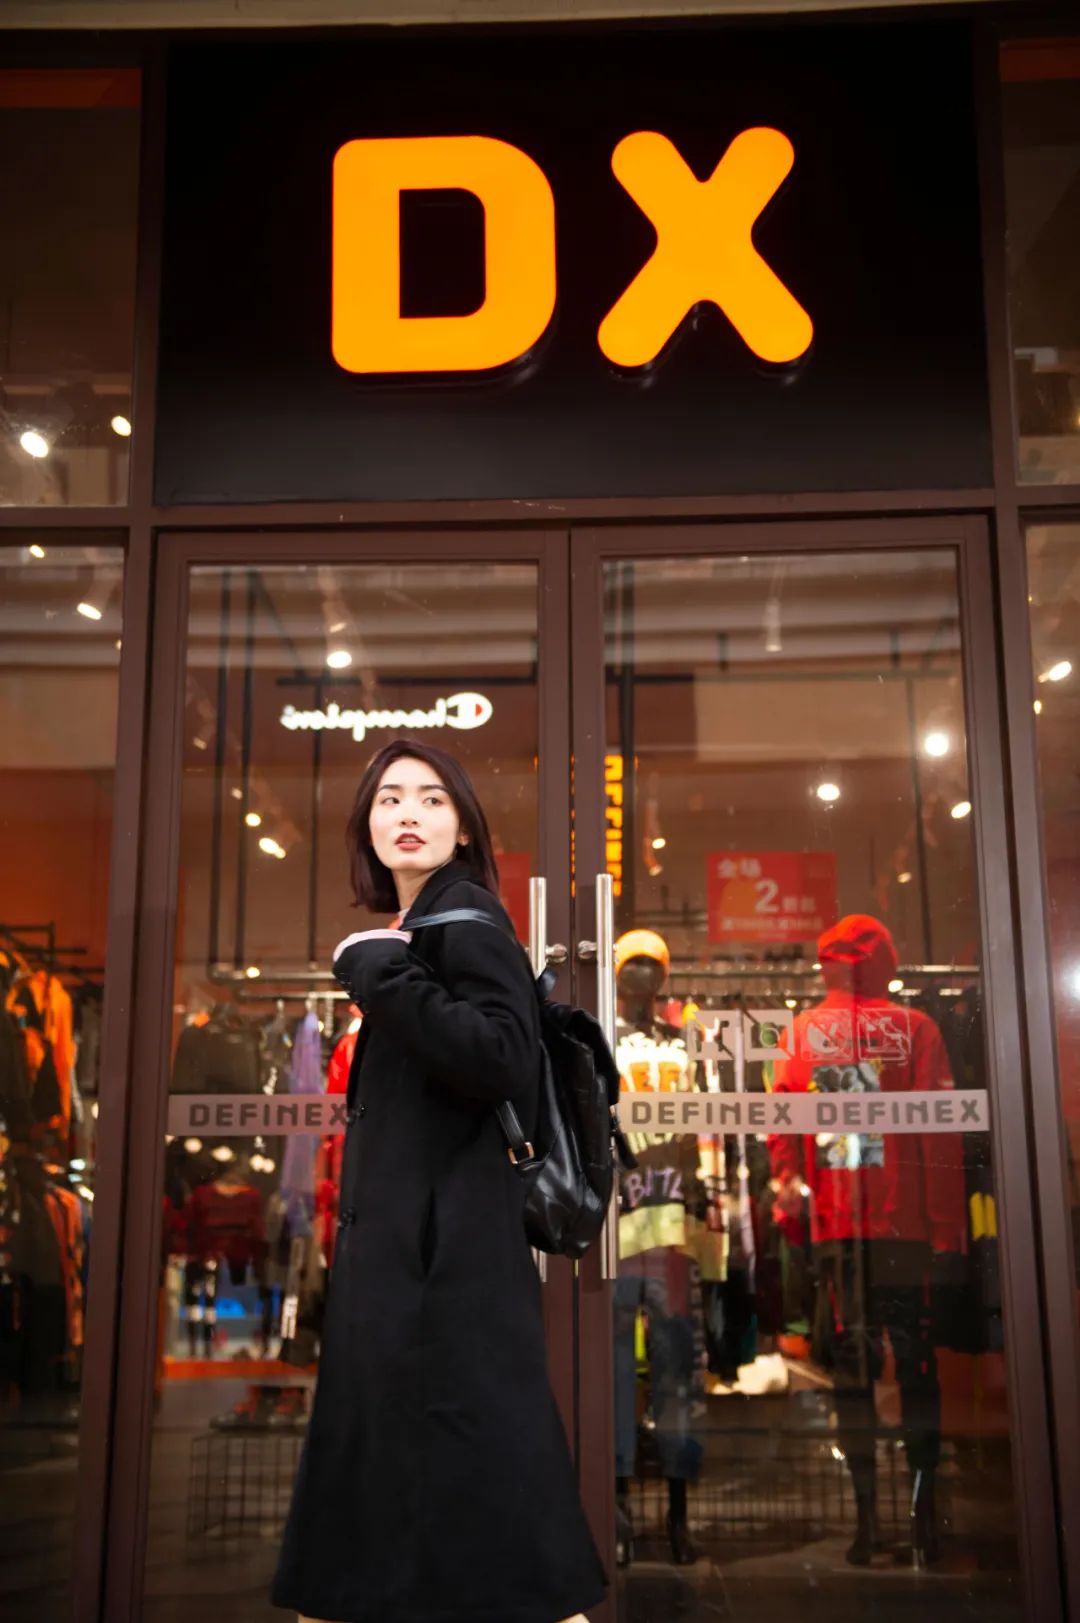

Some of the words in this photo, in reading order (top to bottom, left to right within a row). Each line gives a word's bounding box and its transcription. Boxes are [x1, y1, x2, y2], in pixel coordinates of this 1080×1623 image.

[332, 126, 814, 374] DX
[189, 1103, 348, 1127] DEFINEX
[631, 1101, 793, 1125] DEFINEX
[816, 1099, 981, 1126] DEFINEX
